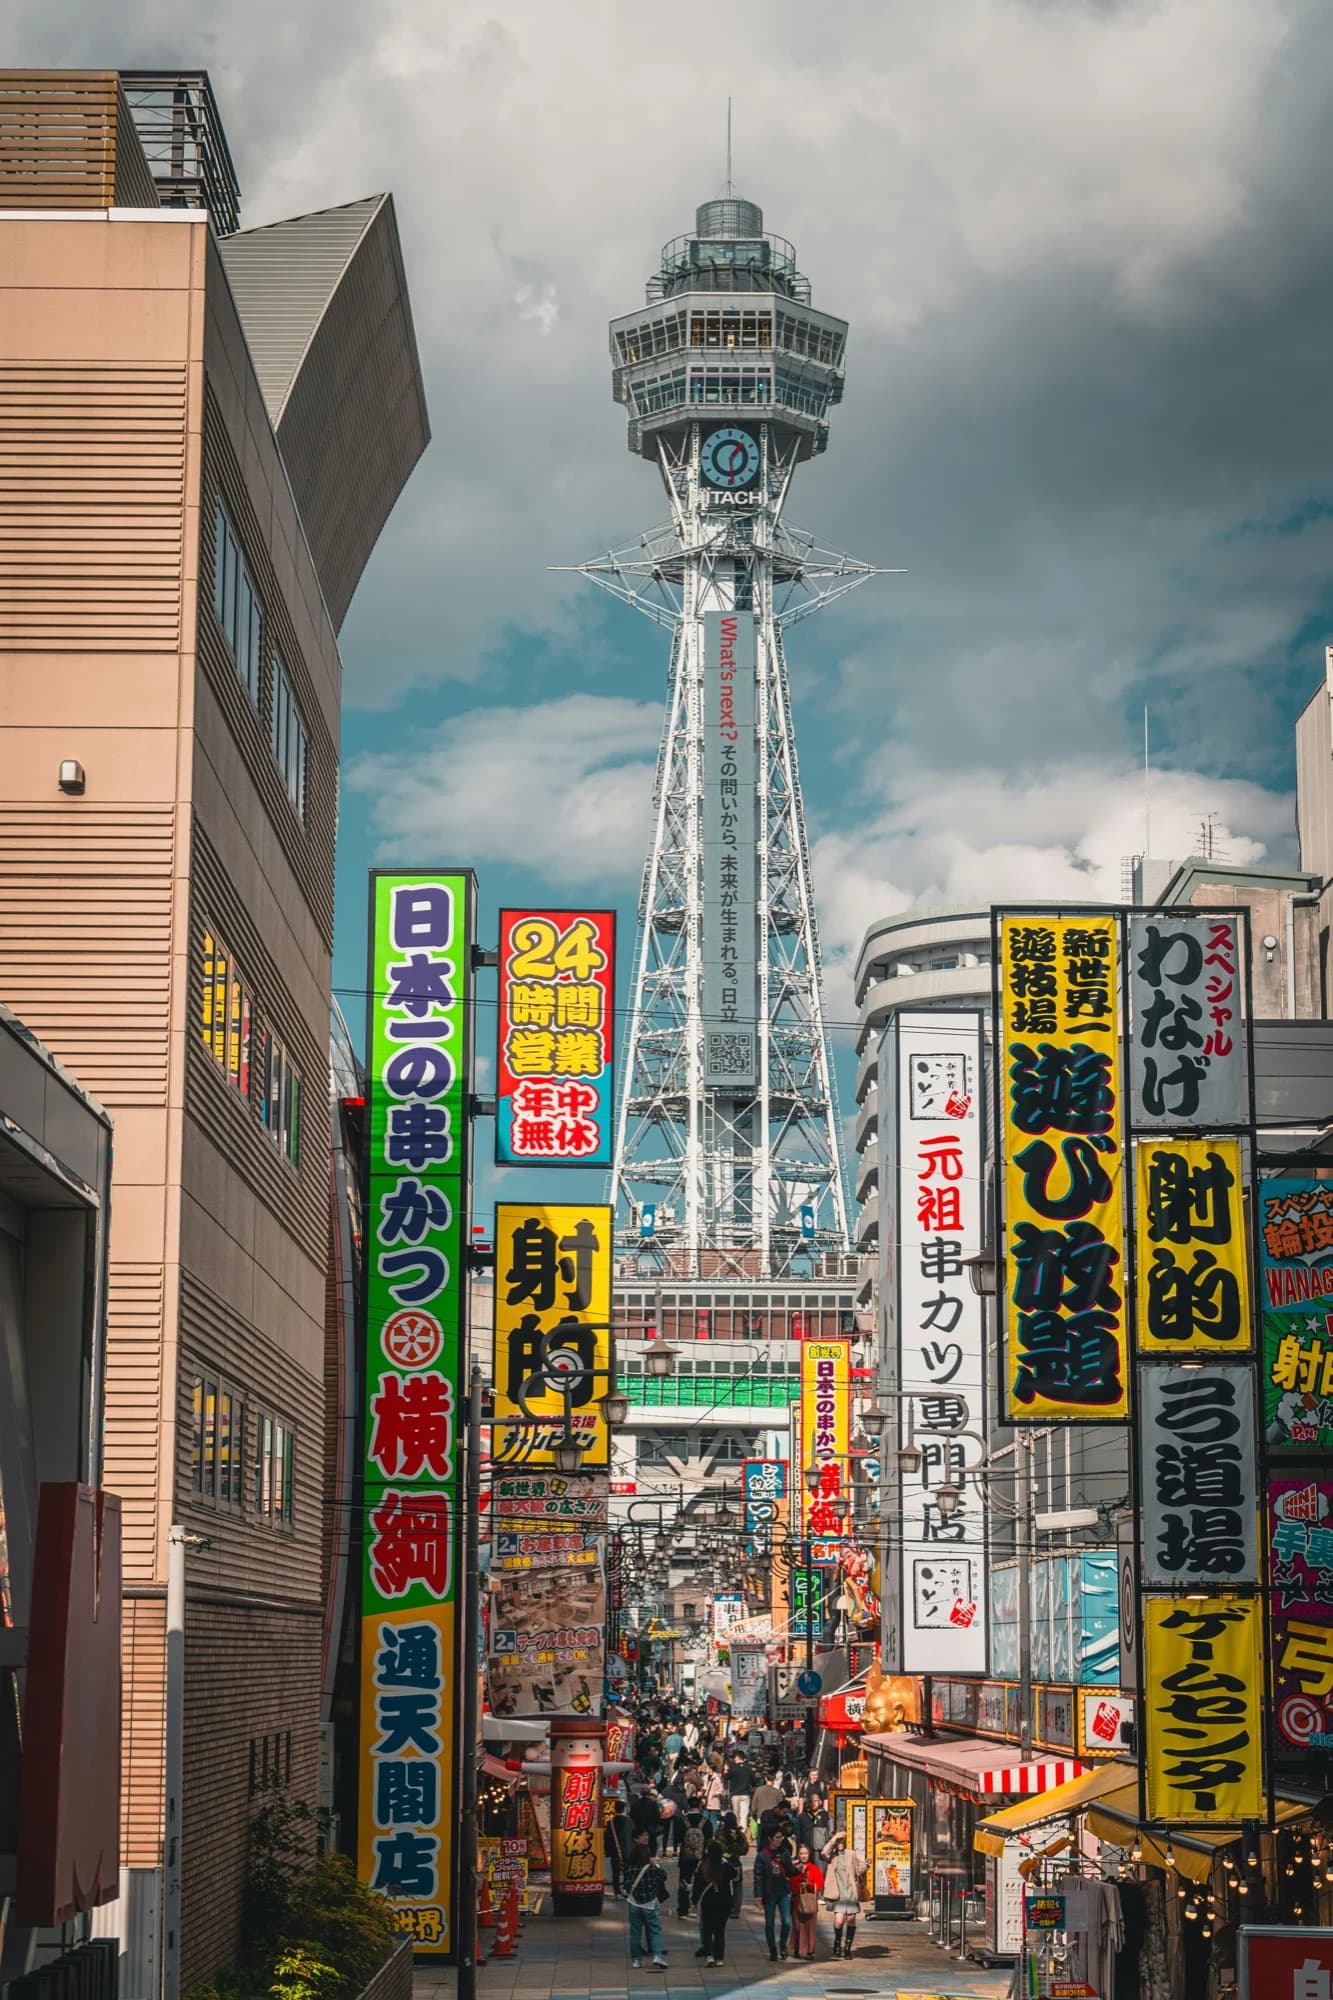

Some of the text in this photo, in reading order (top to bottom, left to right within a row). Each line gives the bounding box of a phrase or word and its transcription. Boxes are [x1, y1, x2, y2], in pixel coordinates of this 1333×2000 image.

[719, 616, 738, 741] What's next?
[507, 981, 605, 1030] 時間
[508, 917, 607, 981] 24
[1009, 926, 1058, 1035] 遊技場
[1203, 924, 1235, 1057] スペシャル
[506, 1028, 605, 1078] 営業
[1138, 925, 1211, 1118] わなげ
[379, 885, 454, 1306] 日本一の串かつ
[512, 1117, 600, 1156] 無休
[513, 1081, 599, 1118] 年中
[1007, 1041, 1124, 1404] 遊び放題
[1147, 1151, 1241, 1341] 射的
[506, 1218, 600, 1408] 射的
[370, 1372, 454, 1600] 横綱
[500, 1480, 546, 1498] 新世界
[372, 1621, 444, 1898] 通天閣店
[1157, 1606, 1252, 1811] ゲームセンター
[564, 1774, 598, 1880] 射的体験
